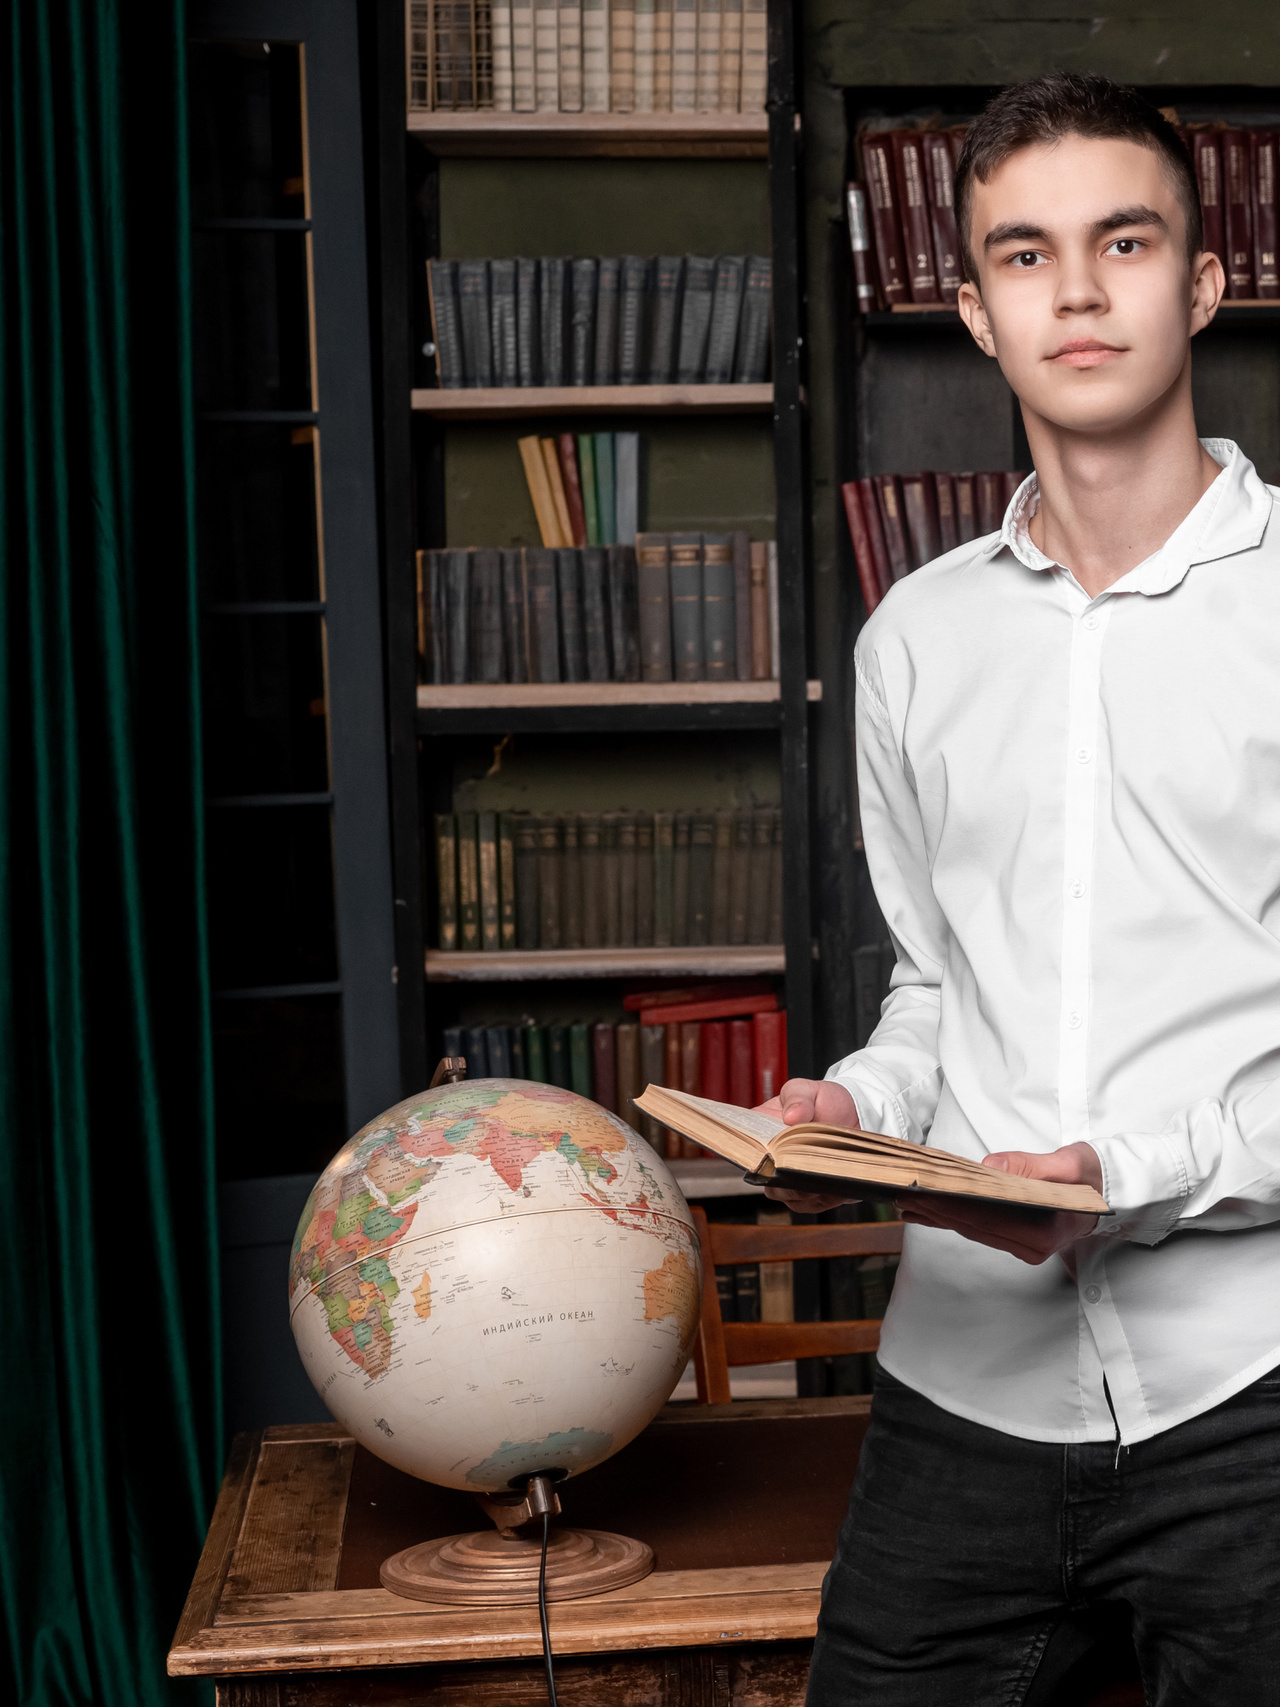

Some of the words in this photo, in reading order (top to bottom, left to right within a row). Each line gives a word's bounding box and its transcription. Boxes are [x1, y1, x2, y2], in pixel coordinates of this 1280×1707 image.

[917, 253, 927, 268] 2
[944, 254, 955, 268] 3
[482, 1312, 554, 1336] ИНДИЙСКИЙ
[559, 1310, 595, 1322] ОКЕАН
